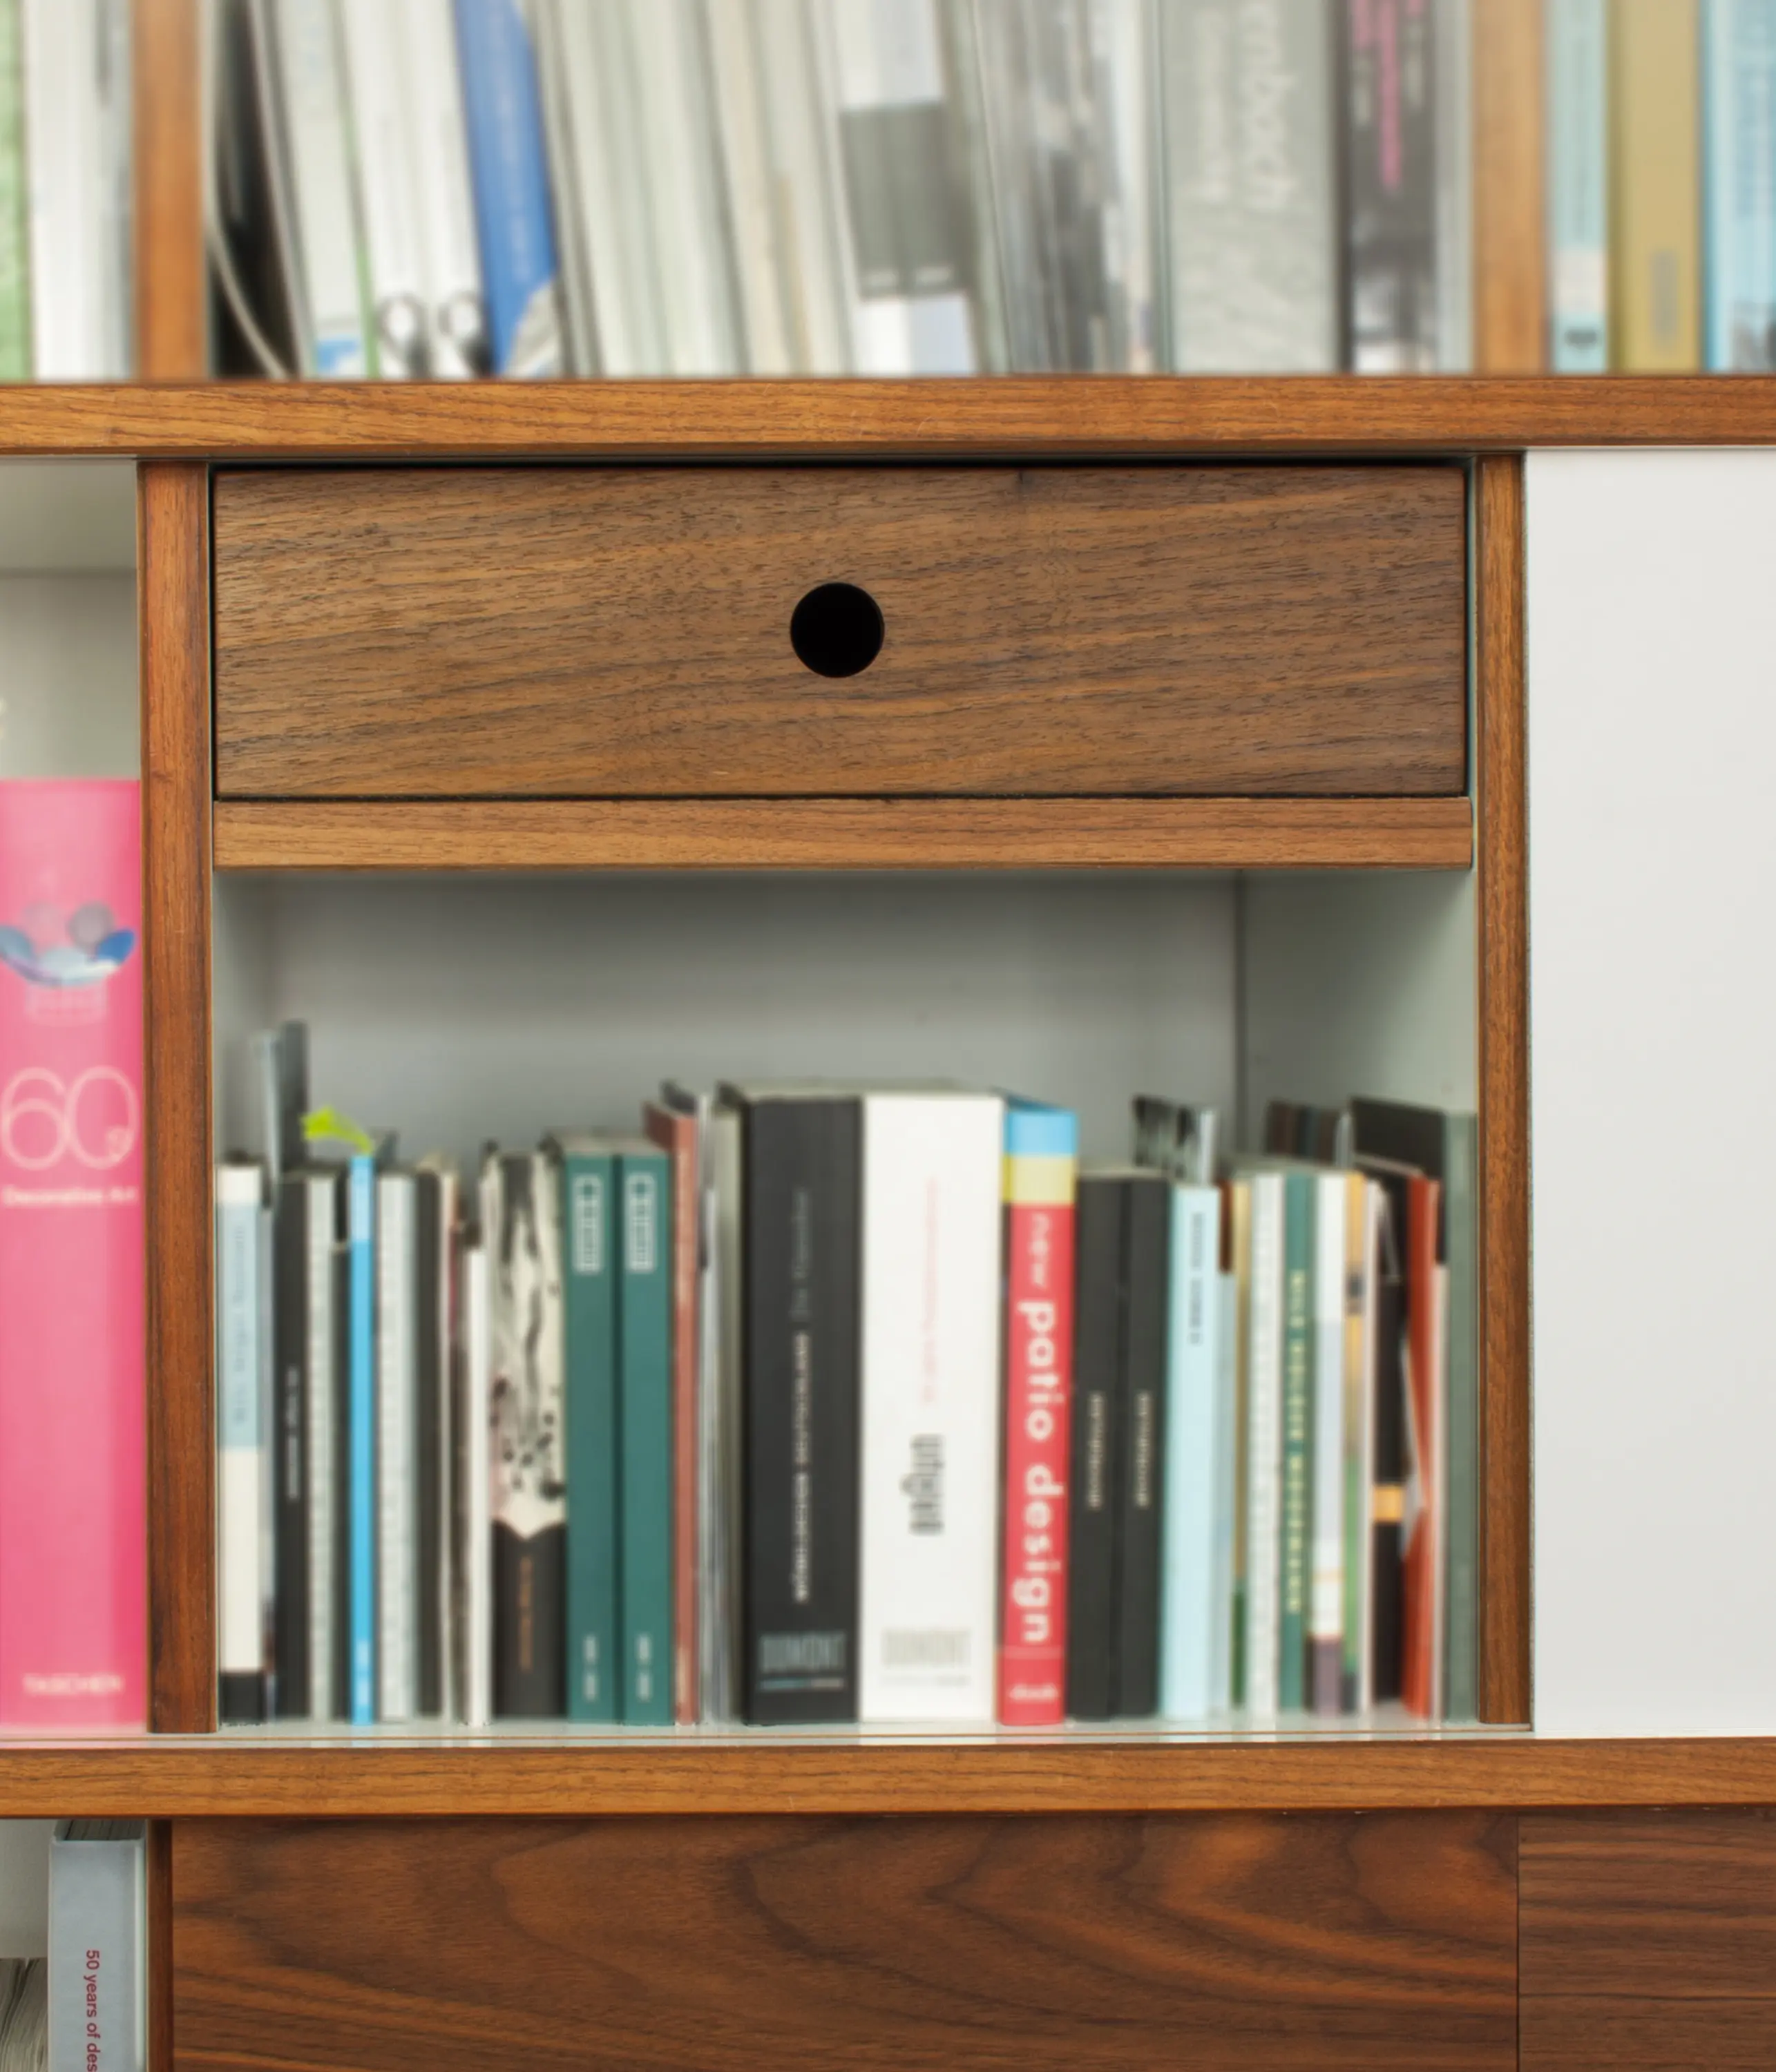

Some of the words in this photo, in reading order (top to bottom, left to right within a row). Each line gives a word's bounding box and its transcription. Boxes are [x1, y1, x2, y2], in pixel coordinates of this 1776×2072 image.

[1028, 1214, 1053, 1287] new
[1017, 1301, 1064, 1442] patio
[1013, 1464, 1064, 1642] design
[86, 1950, 99, 1970] 50
[84, 1975, 97, 2017] years
[86, 2022, 101, 2039] of
